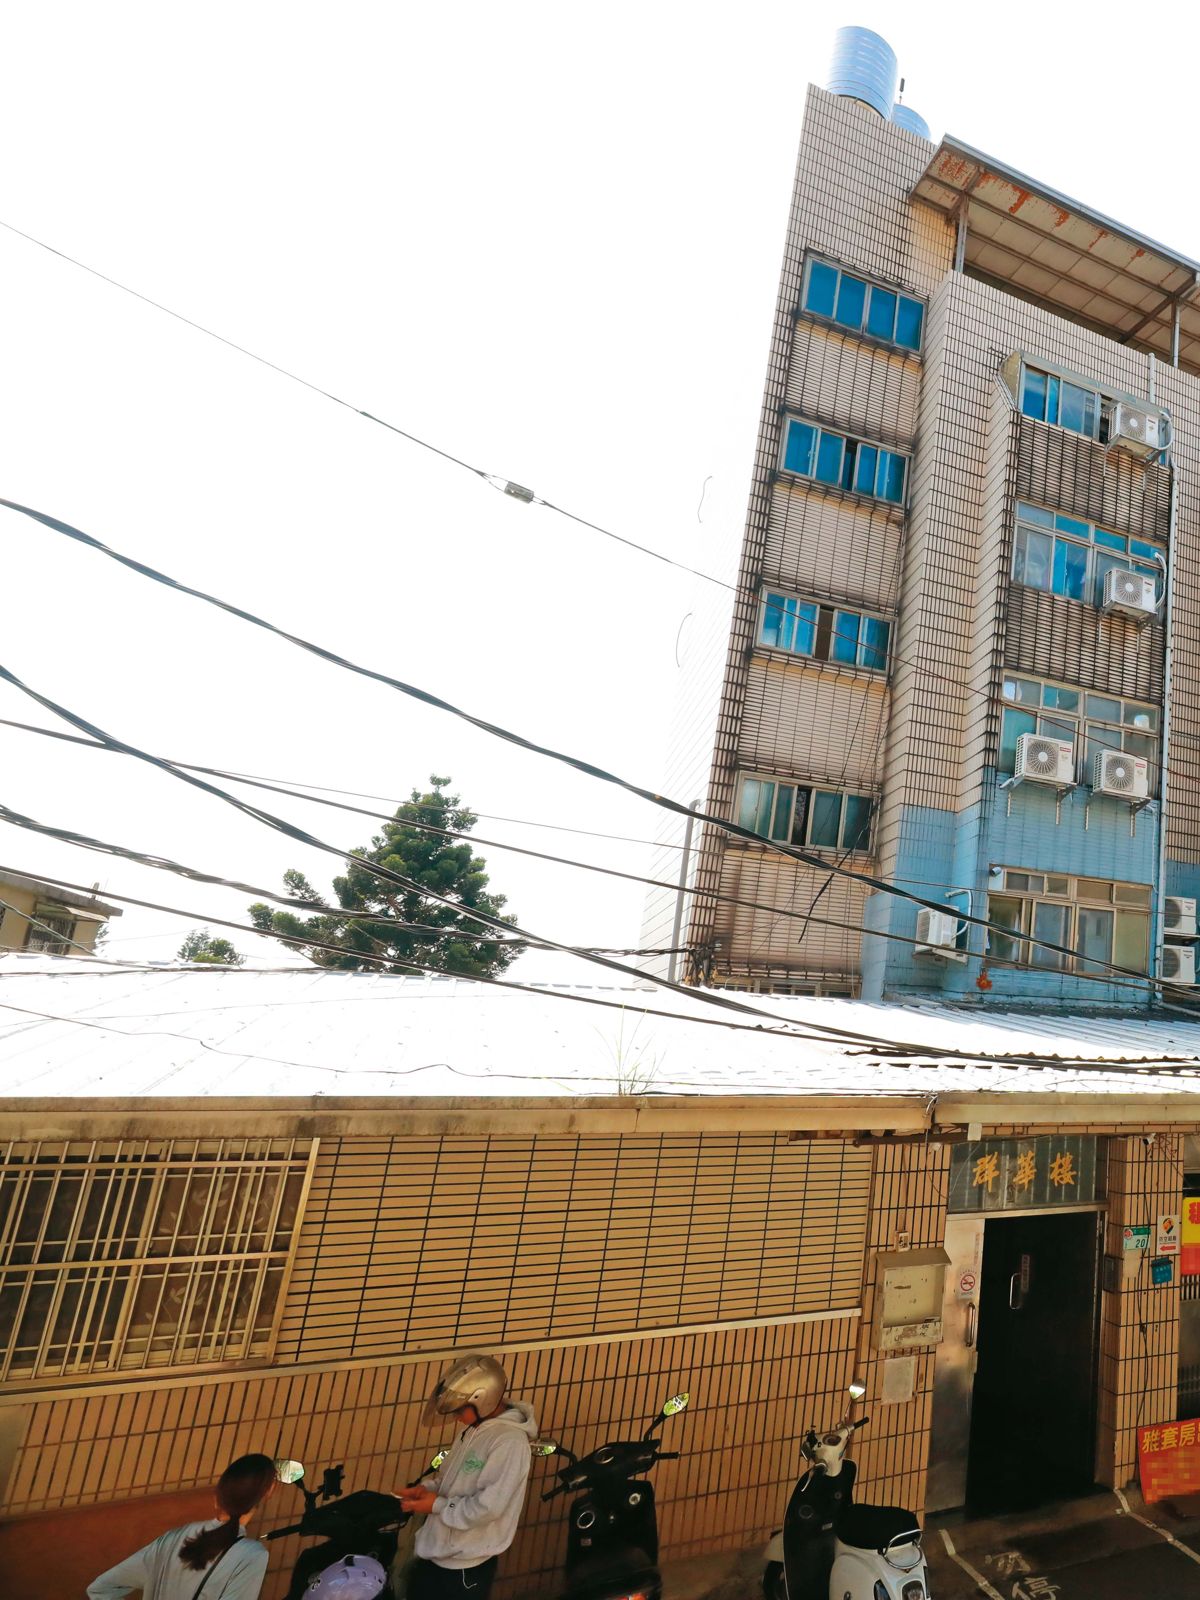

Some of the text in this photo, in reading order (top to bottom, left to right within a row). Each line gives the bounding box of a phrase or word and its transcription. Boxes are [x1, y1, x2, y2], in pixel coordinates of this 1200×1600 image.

[972, 1150, 1077, 1193] 群華樓
[1135, 1238, 1146, 1248] 20
